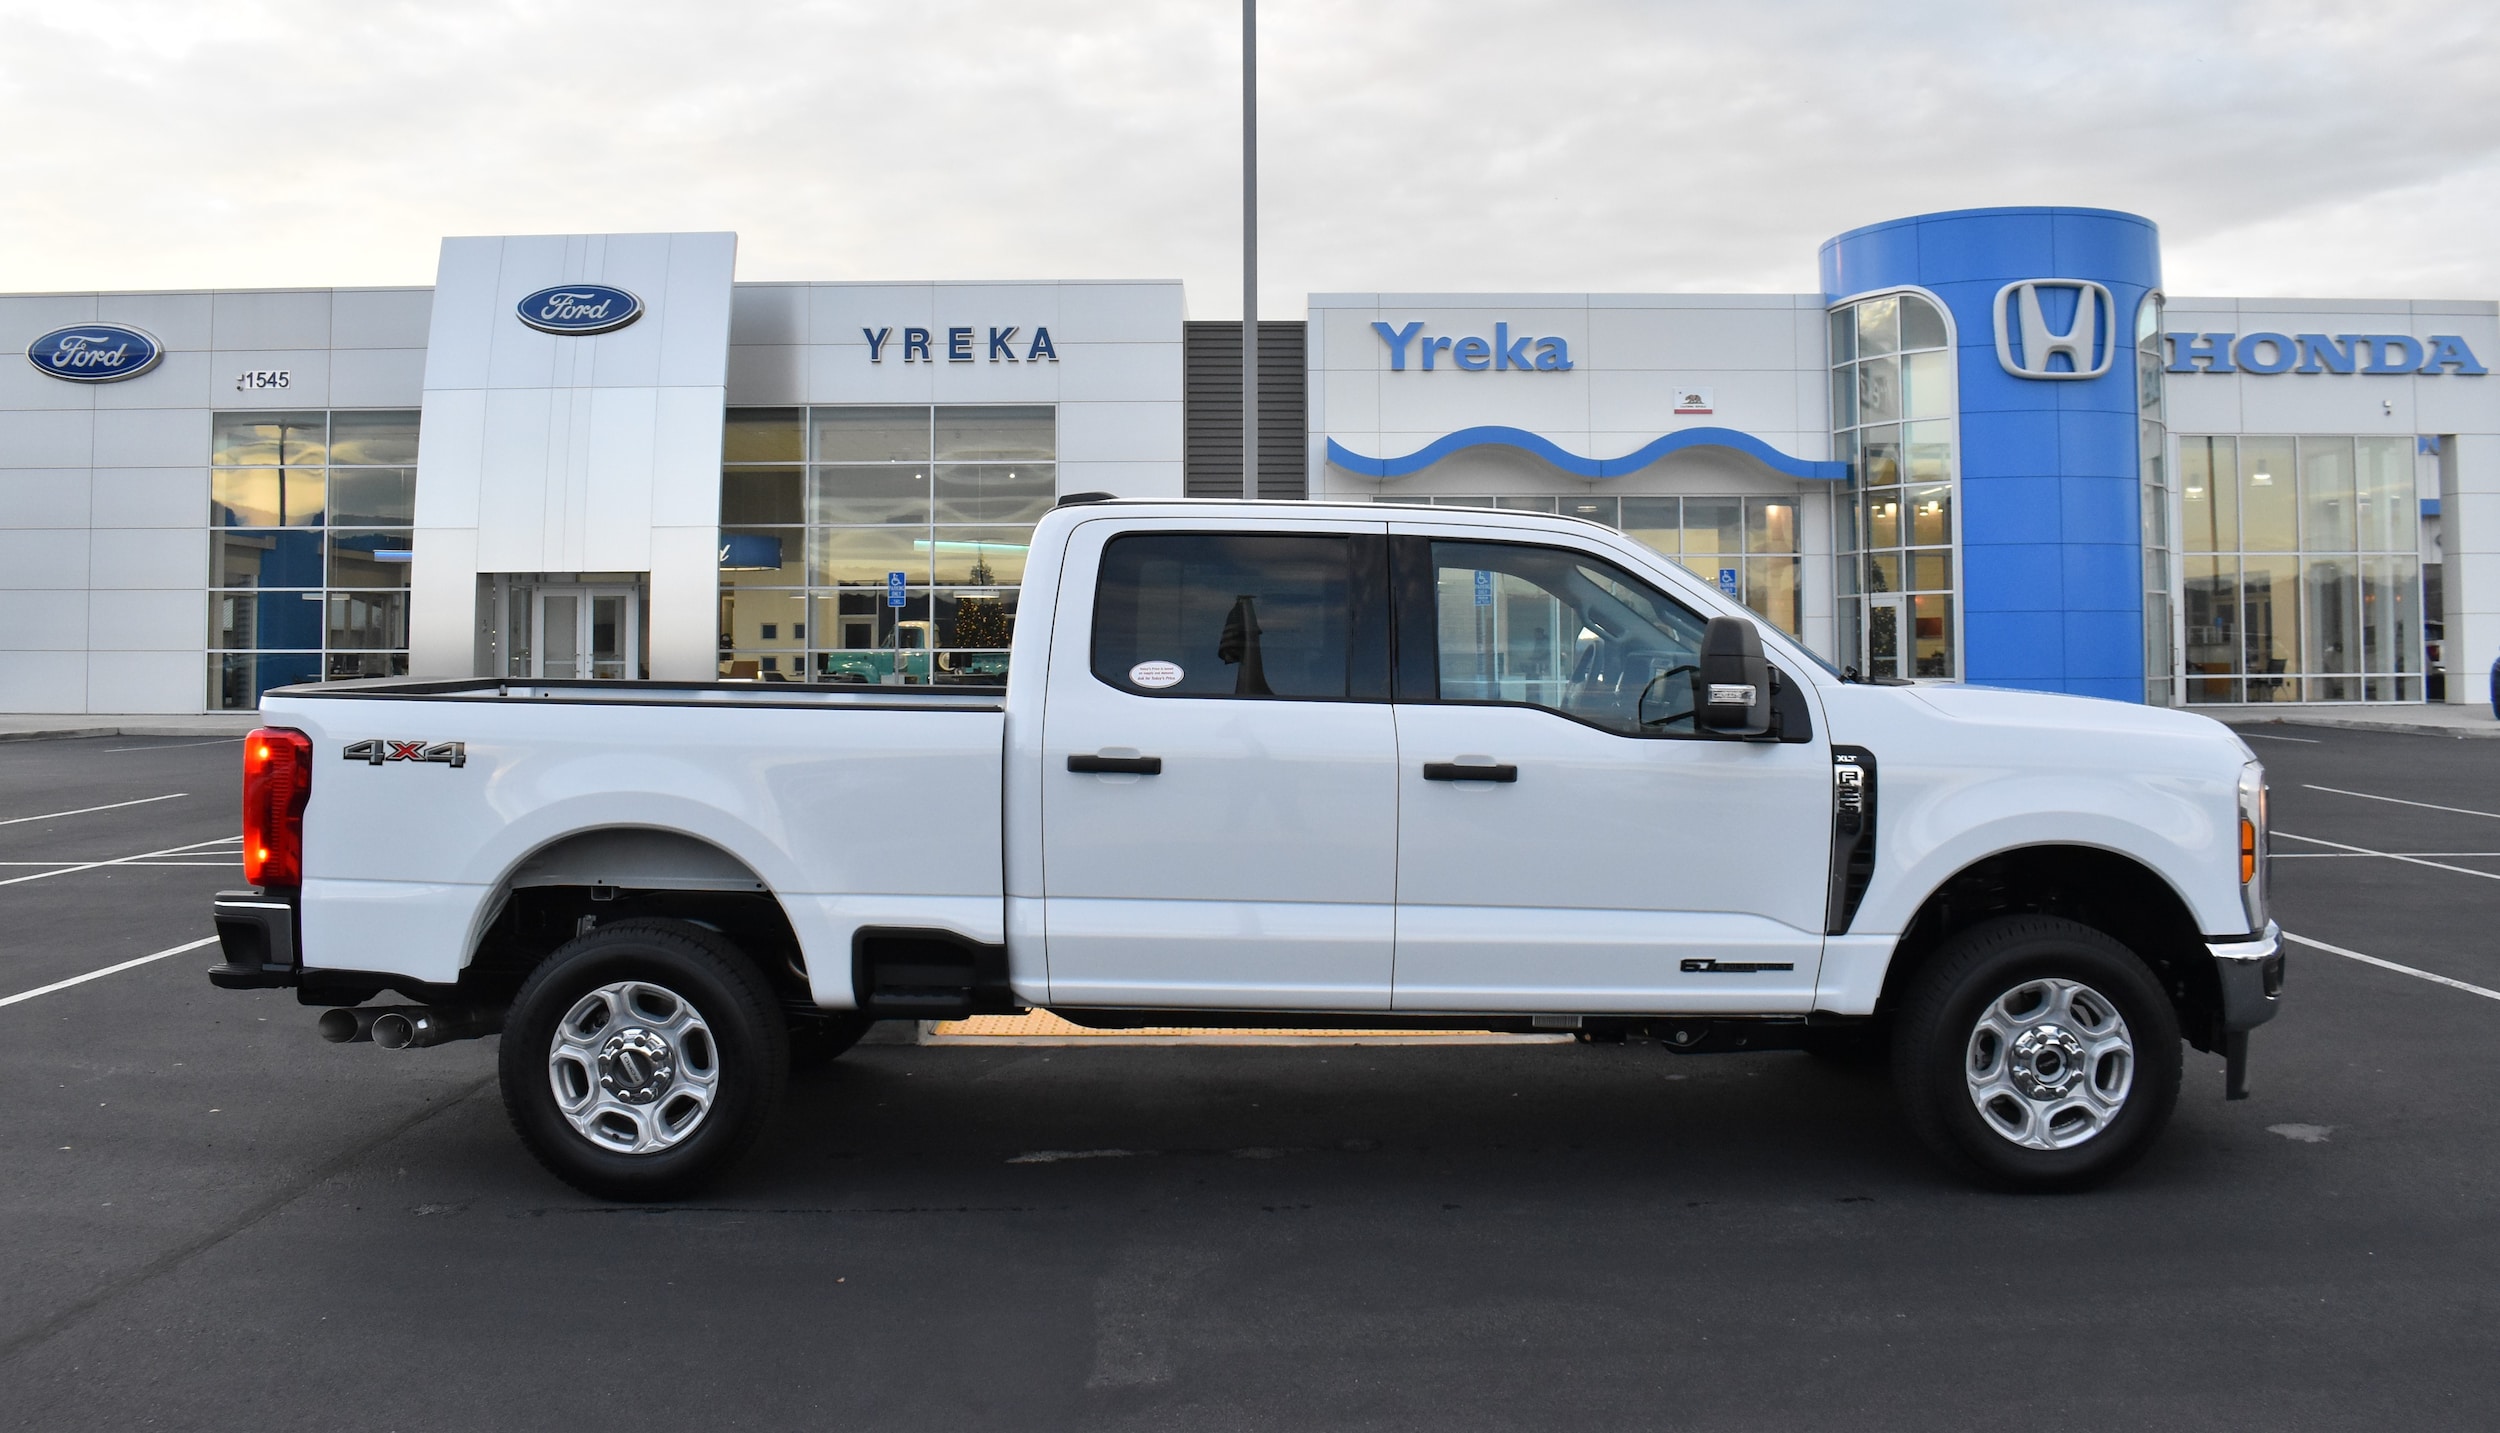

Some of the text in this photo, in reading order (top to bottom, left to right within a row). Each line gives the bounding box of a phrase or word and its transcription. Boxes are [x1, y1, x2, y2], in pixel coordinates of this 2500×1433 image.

[541, 292, 612, 320] Ford
[52, 335, 128, 368] Ford
[863, 327, 1059, 362] YREKA
[1371, 322, 1574, 371] Yreka
[2165, 332, 2489, 375] HONDA
[246, 371, 289, 388] 1545
[1836, 754, 1857, 762] XLT
